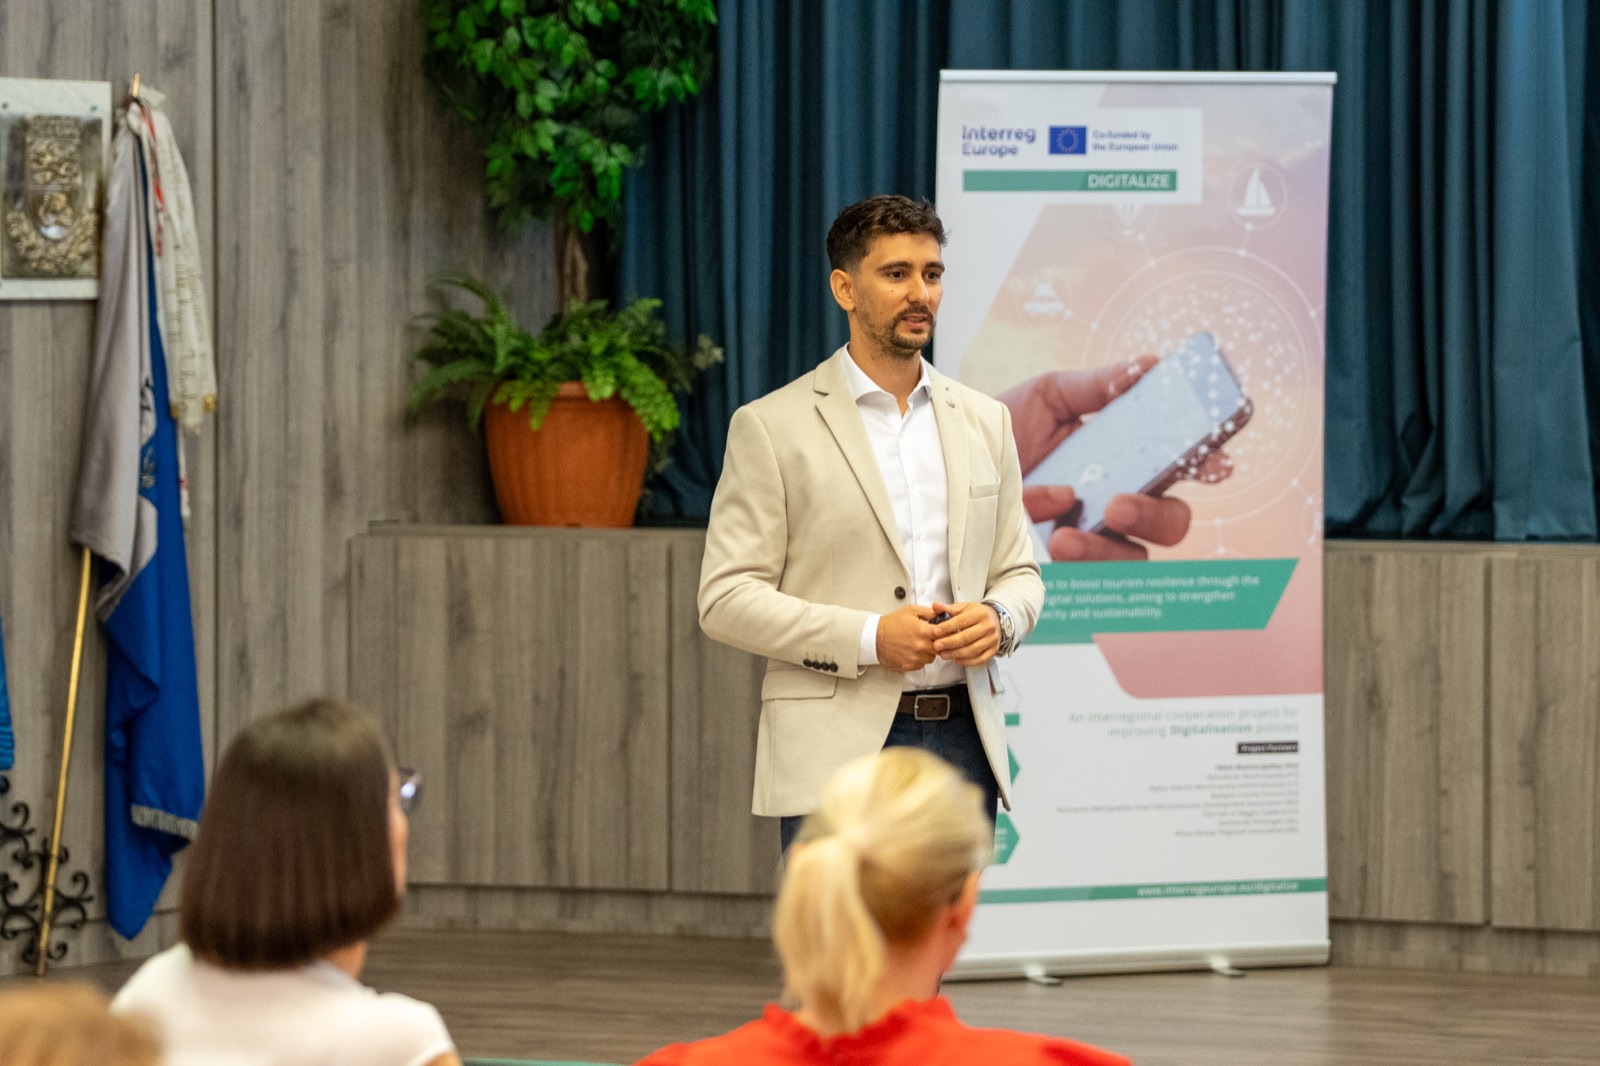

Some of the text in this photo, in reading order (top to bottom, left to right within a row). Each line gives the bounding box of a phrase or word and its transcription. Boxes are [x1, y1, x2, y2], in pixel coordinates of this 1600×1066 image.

[962, 125, 1037, 143] Interreg
[1092, 130, 1151, 142] Co-funded by
[962, 142, 1019, 158] Europe
[1092, 142, 1178, 153] the European Union
[1087, 173, 1170, 189] DIGITALIZE
[1102, 577, 1144, 589] tourism
[1147, 576, 1194, 588] resilience
[1197, 575, 1239, 589] through
[1241, 574, 1259, 586] the
[1045, 593, 1072, 607] igital
[1128, 591, 1163, 605] aiming
[1179, 590, 1236, 604] strengthen
[1070, 607, 1090, 618] and
